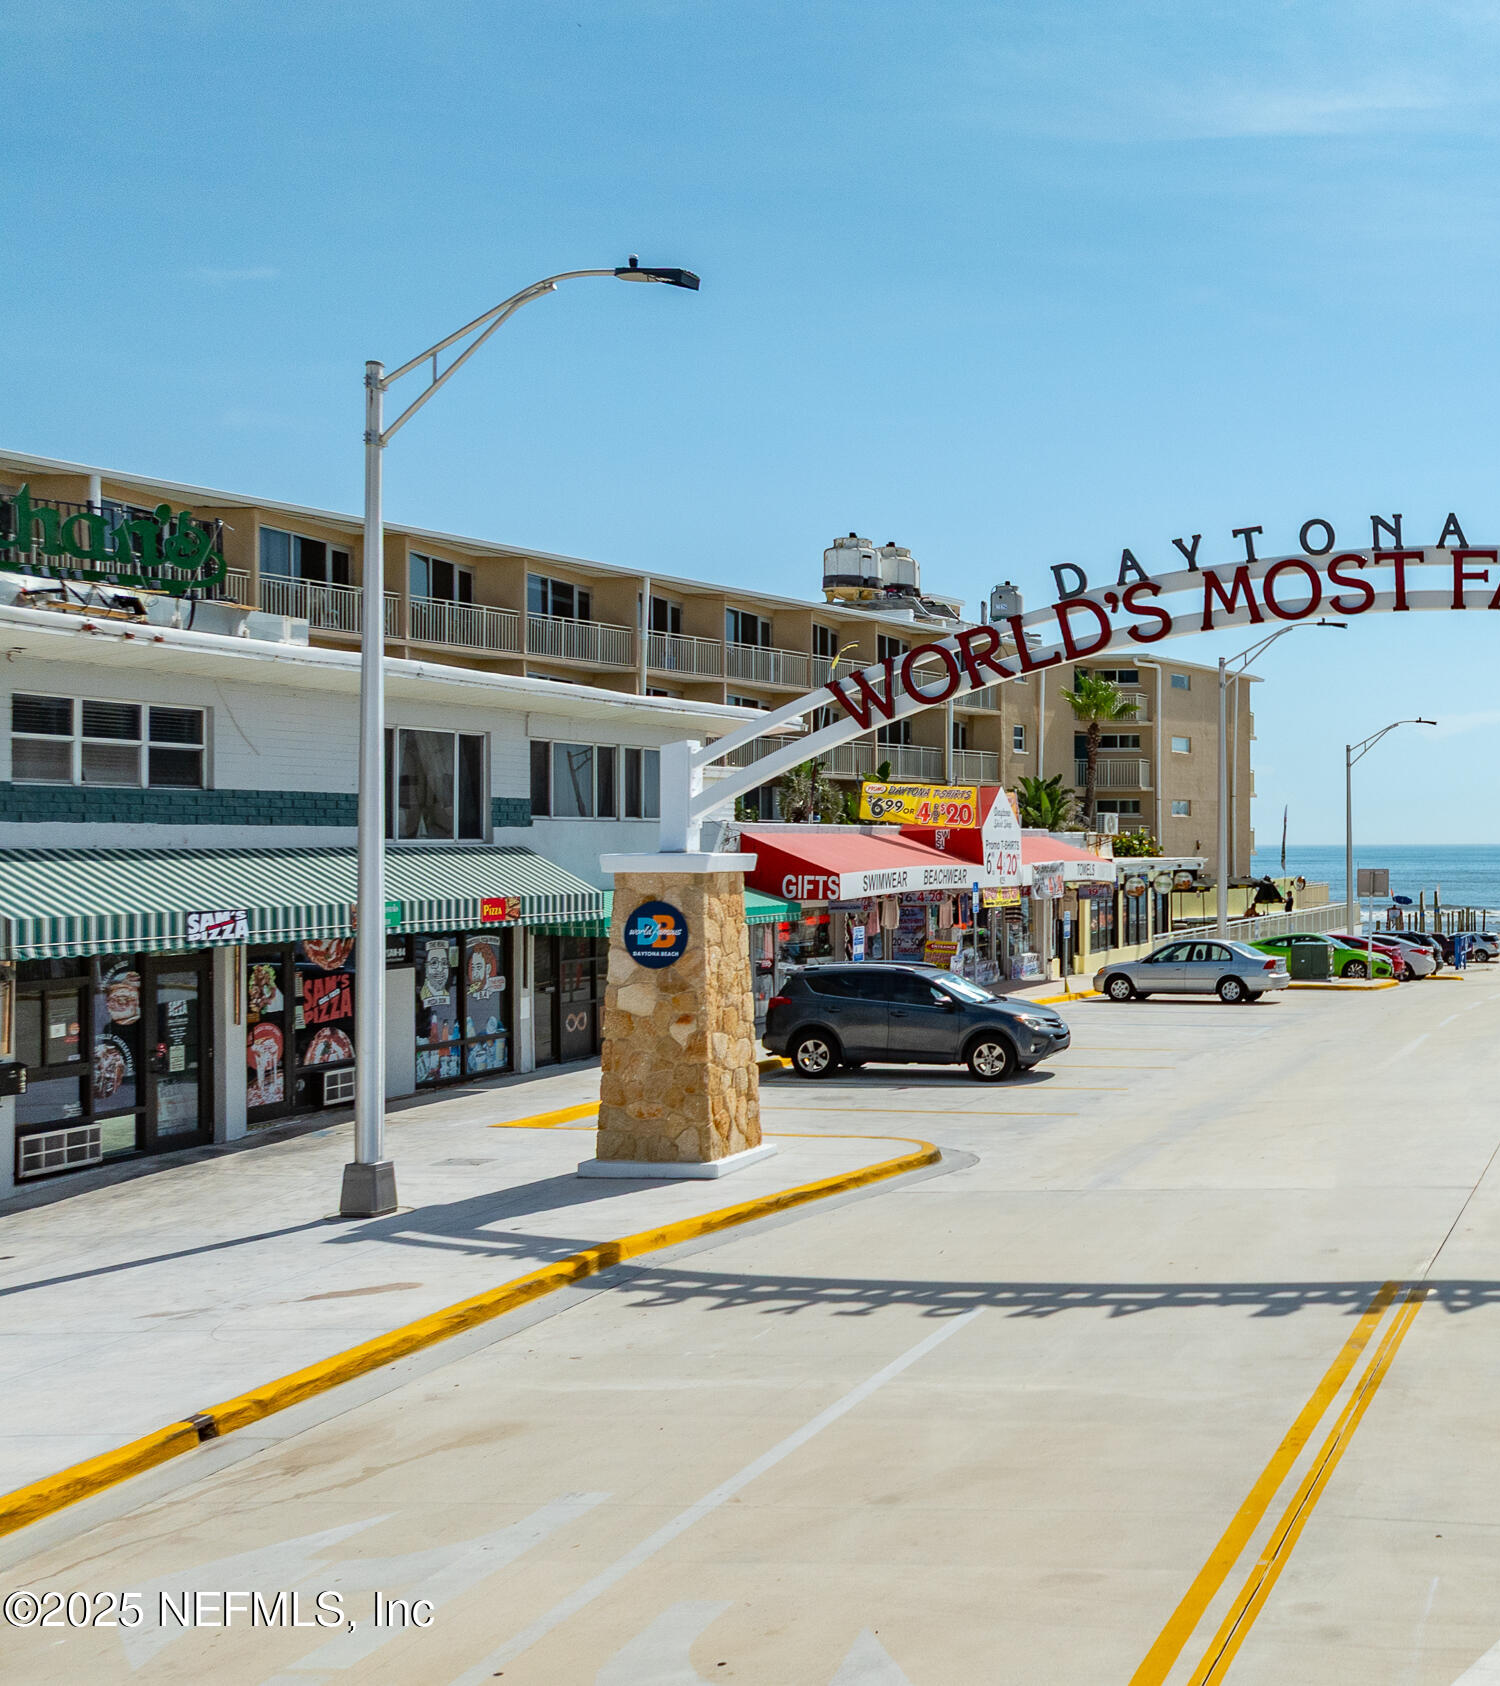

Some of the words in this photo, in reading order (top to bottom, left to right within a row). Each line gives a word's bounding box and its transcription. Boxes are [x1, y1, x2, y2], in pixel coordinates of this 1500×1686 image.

[1050, 513, 1469, 600] DAYTONA
[824, 581, 1173, 730] WORLD'S
[1200, 551, 1424, 631] MOST
[888, 785, 931, 797] DAYTONA
[915, 801, 931, 824] 4
[940, 802, 973, 825] $20
[782, 874, 840, 900] GIFTS
[863, 871, 908, 892] SWIMWEAR
[924, 869, 967, 886] BEACHWEAR
[187, 910, 248, 934] SAM'S
[188, 919, 249, 942] PIZZA
[304, 974, 350, 1011] SAM'S
[304, 988, 352, 1024] PIZZA
